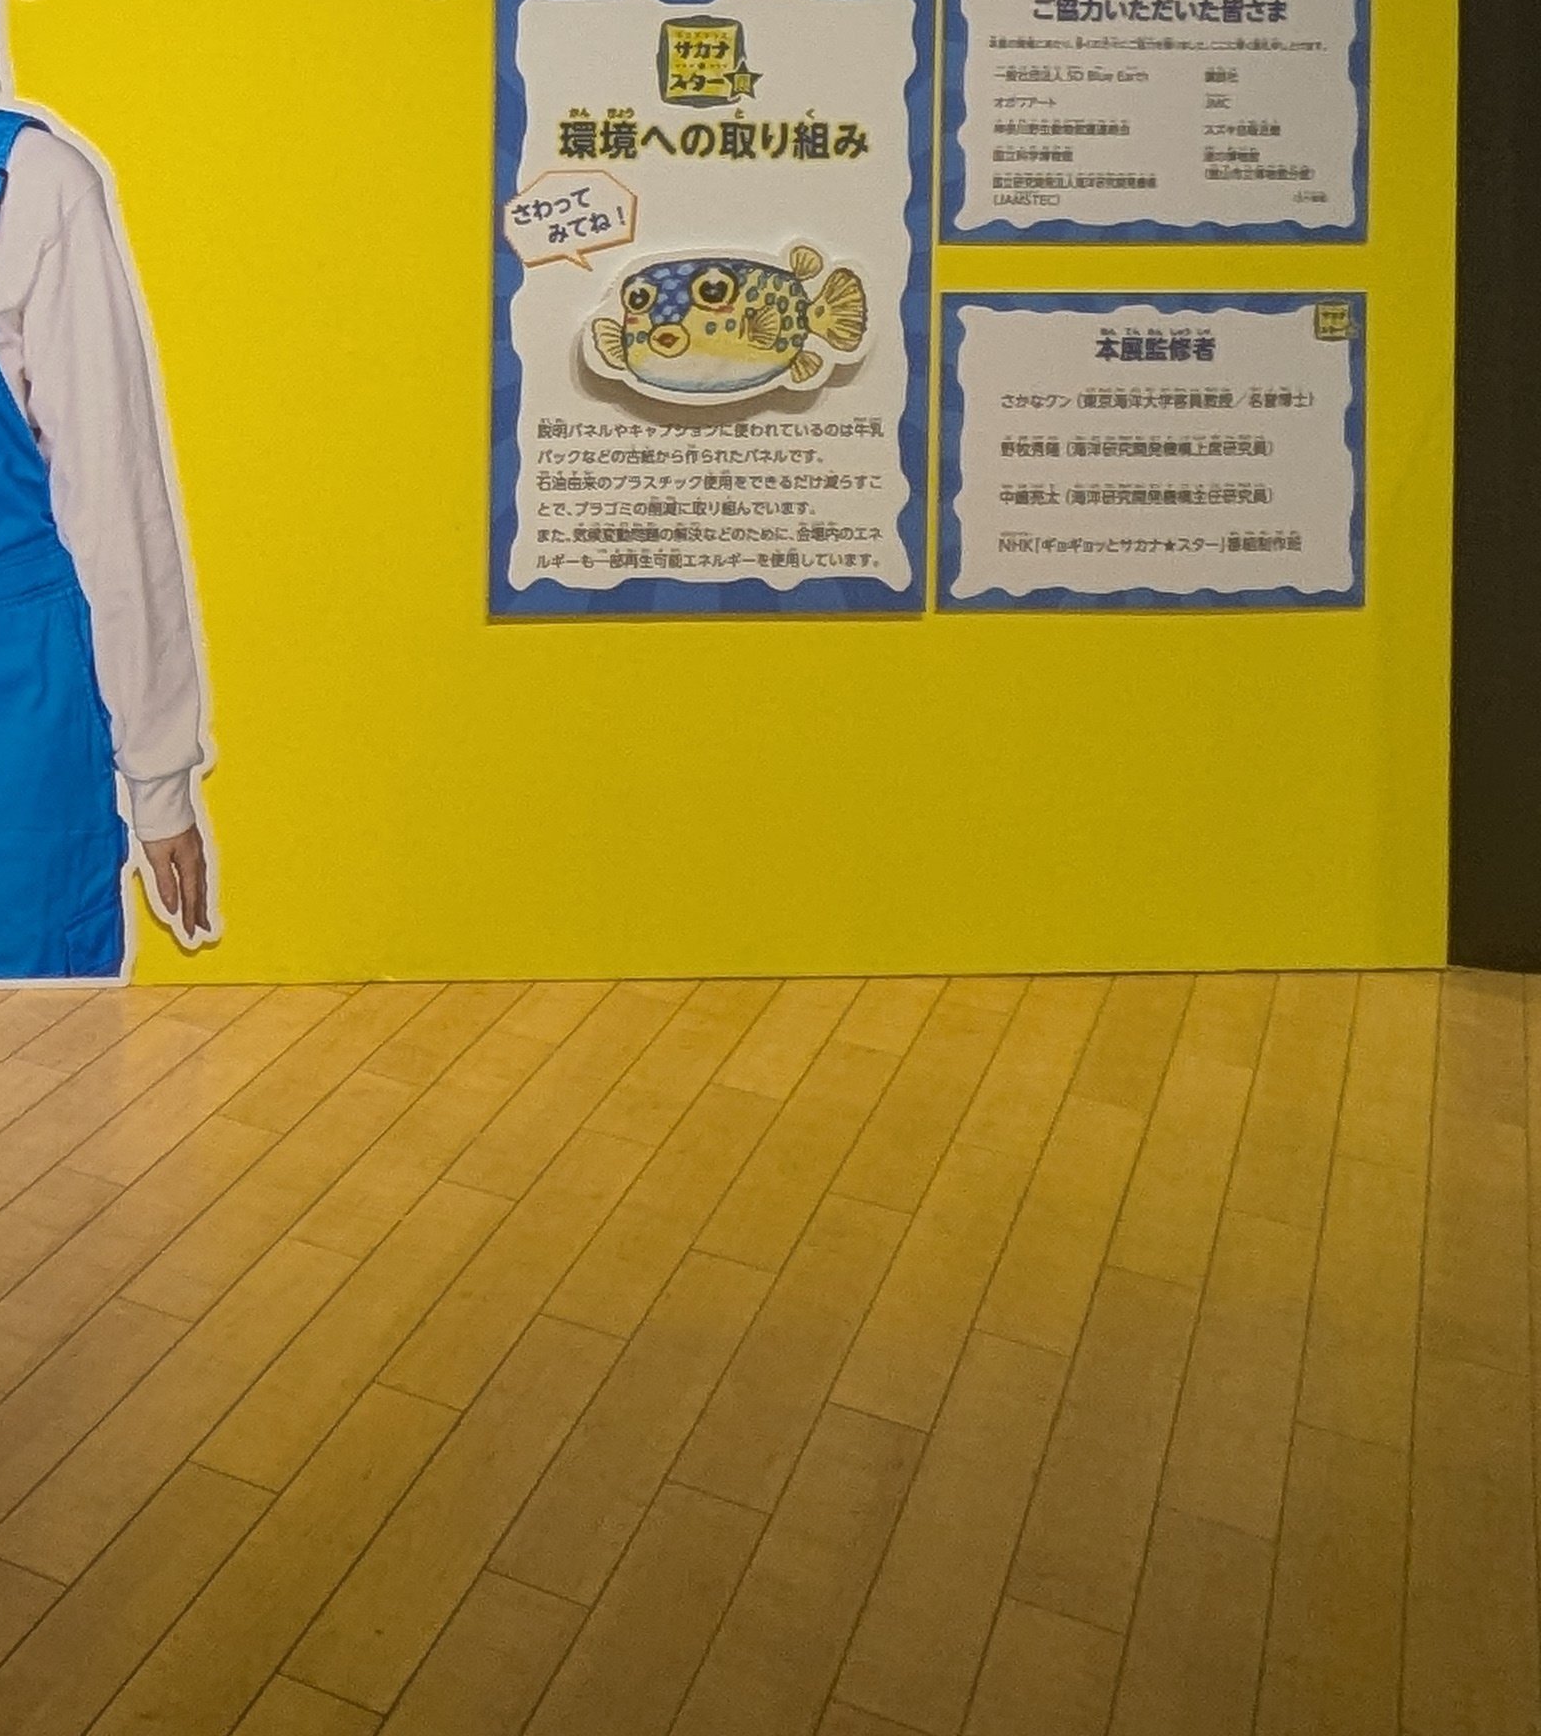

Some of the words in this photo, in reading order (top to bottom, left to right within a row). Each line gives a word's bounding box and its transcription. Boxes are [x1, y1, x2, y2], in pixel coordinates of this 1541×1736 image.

[674, 41, 730, 59] サカナ
[670, 72, 725, 92] スター
[558, 121, 869, 161] 環境への取り組み
[511, 186, 592, 226] さわって
[1095, 337, 1216, 362] 本展監修者
[1001, 393, 1072, 409] さかなクン
